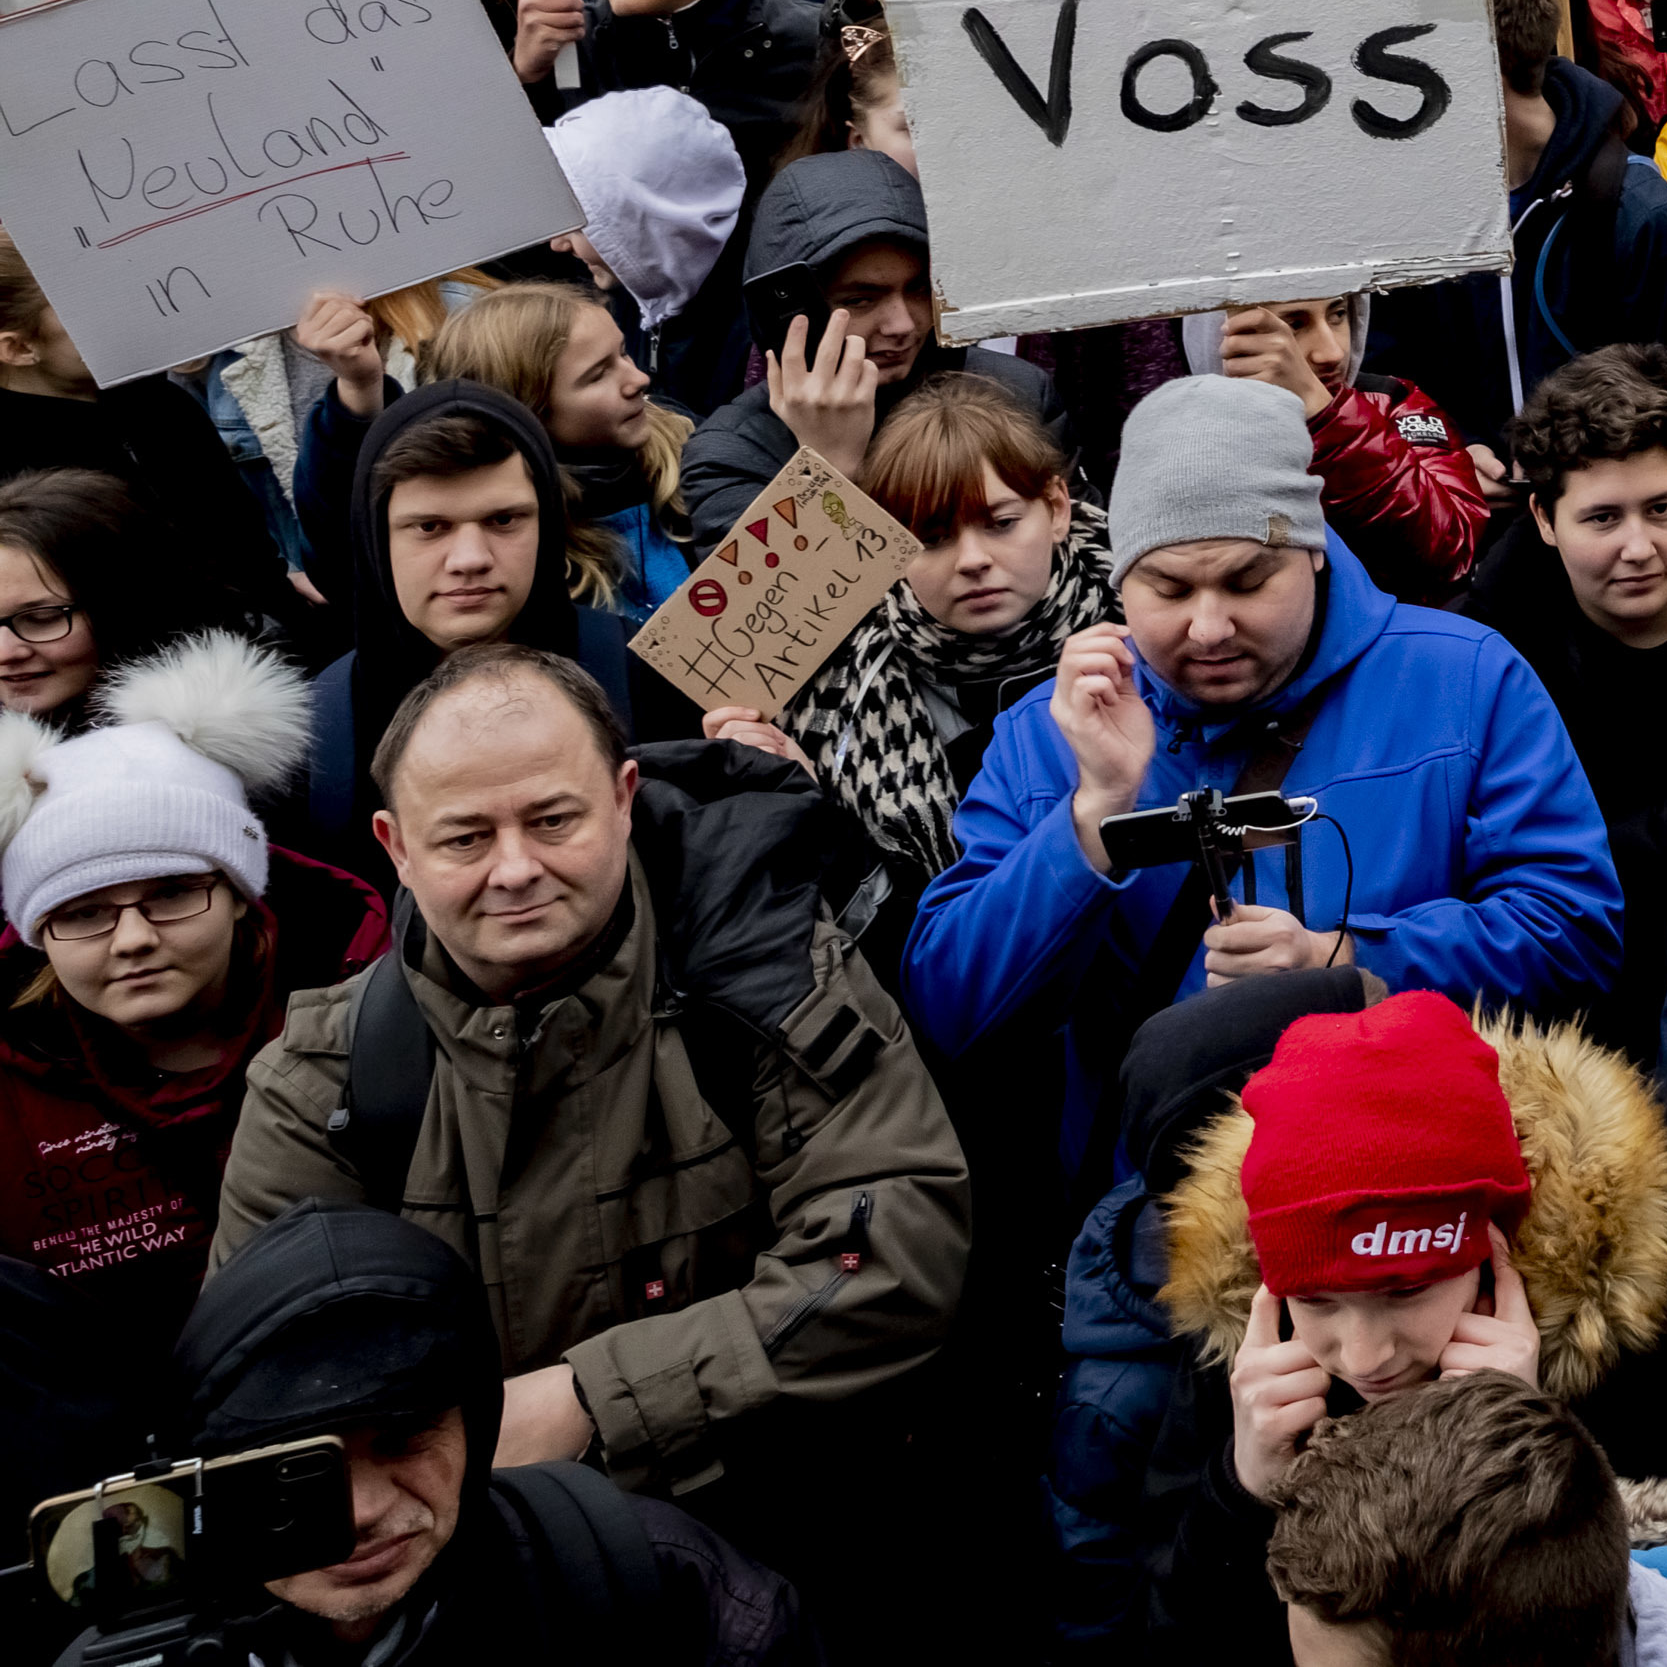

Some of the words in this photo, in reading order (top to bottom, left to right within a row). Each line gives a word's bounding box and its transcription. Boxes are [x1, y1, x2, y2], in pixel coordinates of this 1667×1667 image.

[146, 266, 212, 317] in
[258, 156, 463, 259] Ruhe
[678, 569, 799, 700] #Gegen
[855, 527, 888, 563] 13
[754, 568, 861, 700] Artikel
[70, 1238, 102, 1256] THE
[104, 1222, 158, 1248] WILD
[80, 1224, 102, 1237] THE
[106, 1204, 164, 1231] MAJESTY
[140, 1225, 187, 1253] WAY
[1350, 1210, 1469, 1259] dmsj
